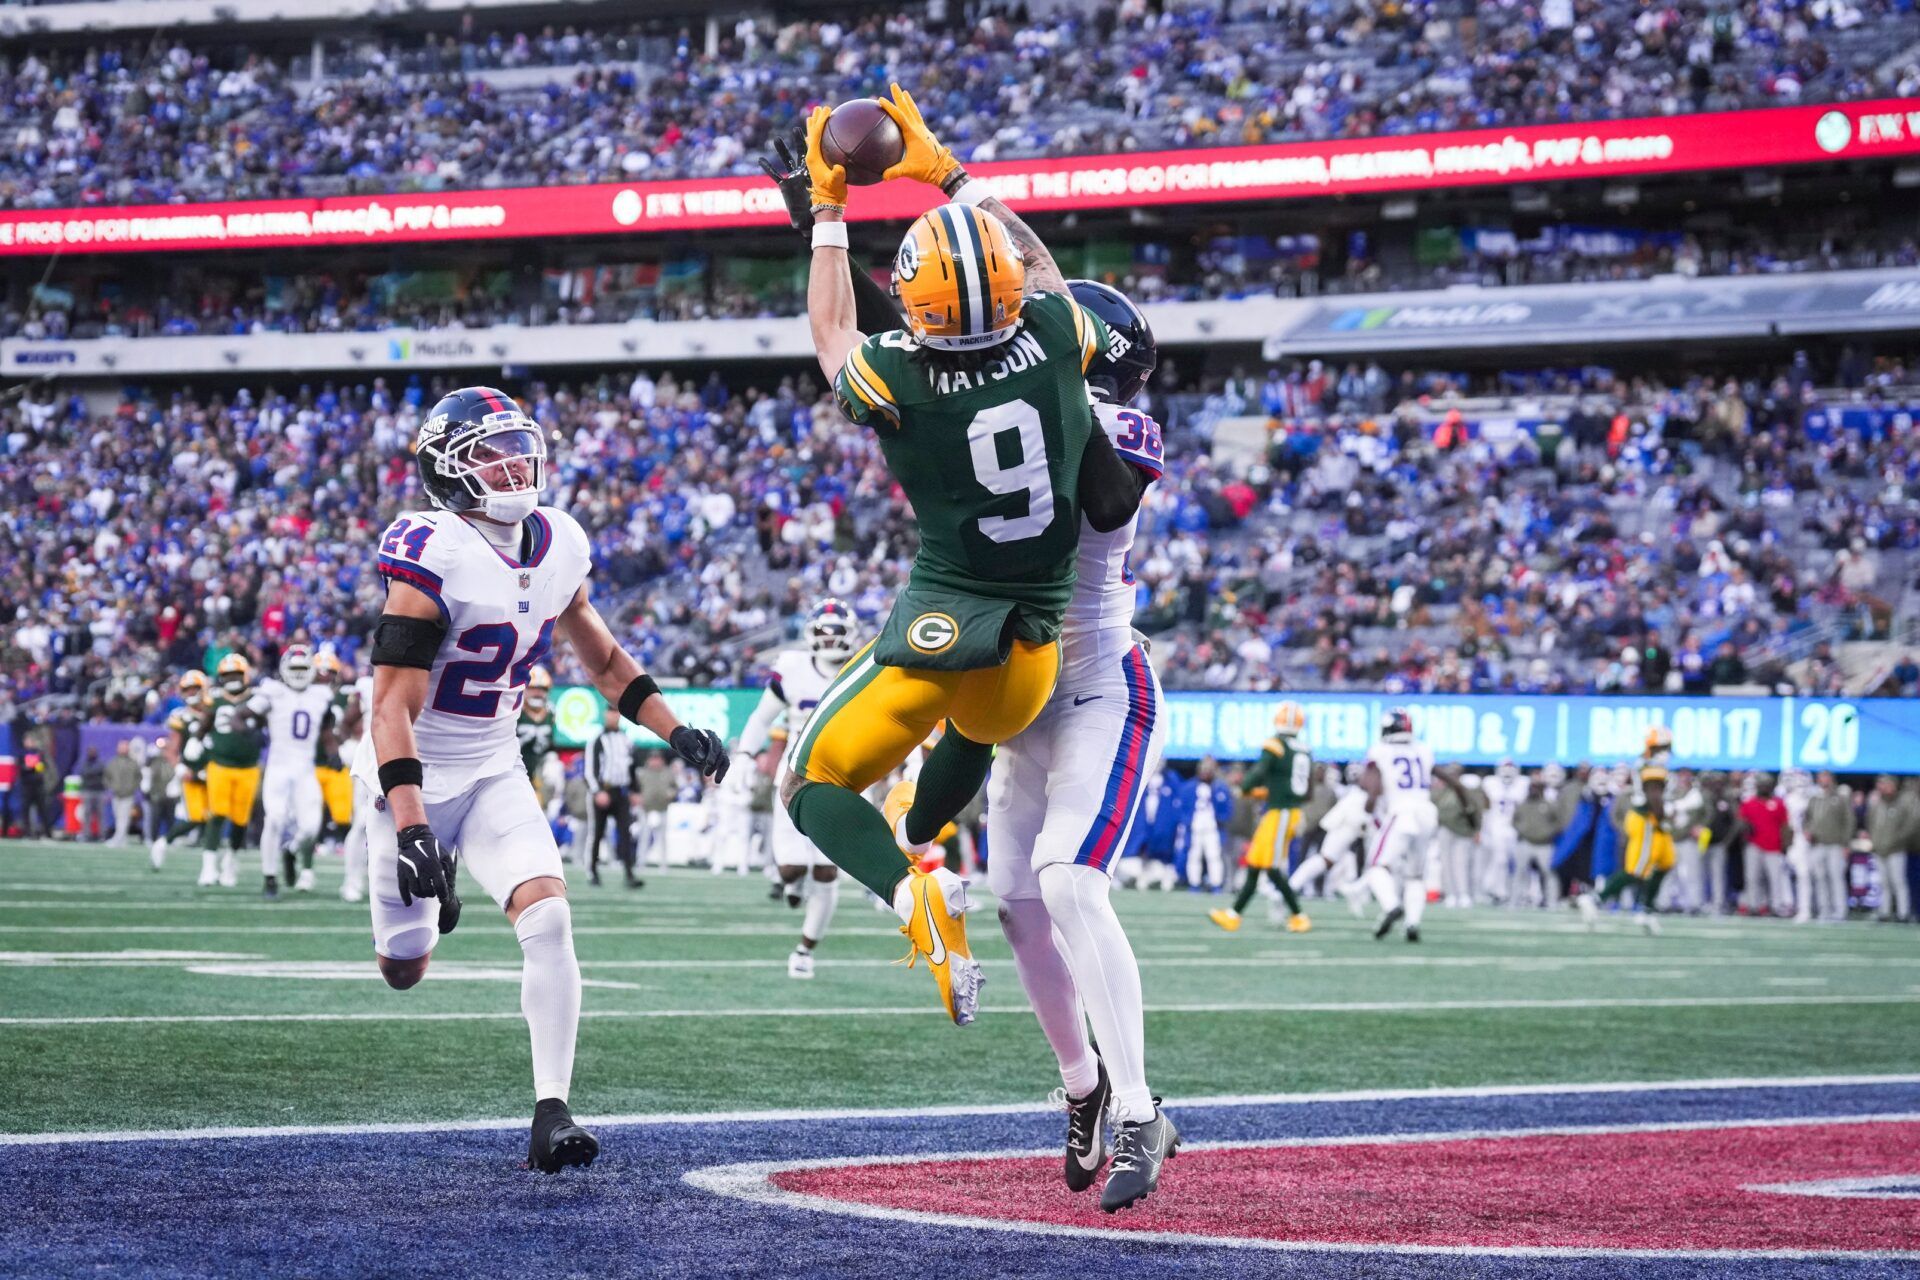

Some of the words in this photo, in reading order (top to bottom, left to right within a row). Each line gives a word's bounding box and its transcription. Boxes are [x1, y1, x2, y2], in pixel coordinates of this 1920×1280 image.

[1070, 168, 1127, 196] PROS
[1127, 166, 1165, 193] GO
[1165, 163, 1209, 192] FOR
[1581, 135, 1603, 164] &
[1604, 134, 1673, 162] more
[16, 221, 63, 244] PROS
[63, 221, 94, 243] GO
[94, 219, 130, 241] FOR
[432, 204, 450, 229] &
[450, 205, 505, 227] more
[959, 334, 994, 346] PACKERS
[1117, 411, 1162, 460] 38
[967, 398, 1055, 544] 9
[382, 518, 434, 562] 24
[911, 617, 953, 649] G
[432, 615, 557, 718] 24
[293, 711, 310, 740] 0
[1219, 702, 1367, 753] QUTER
[1478, 712, 1508, 753] &
[1512, 706, 1535, 754] 7
[1671, 706, 1722, 758] ON
[1723, 708, 1762, 757] 17
[1801, 702, 1860, 767] 20
[1394, 757, 1430, 789] 31
